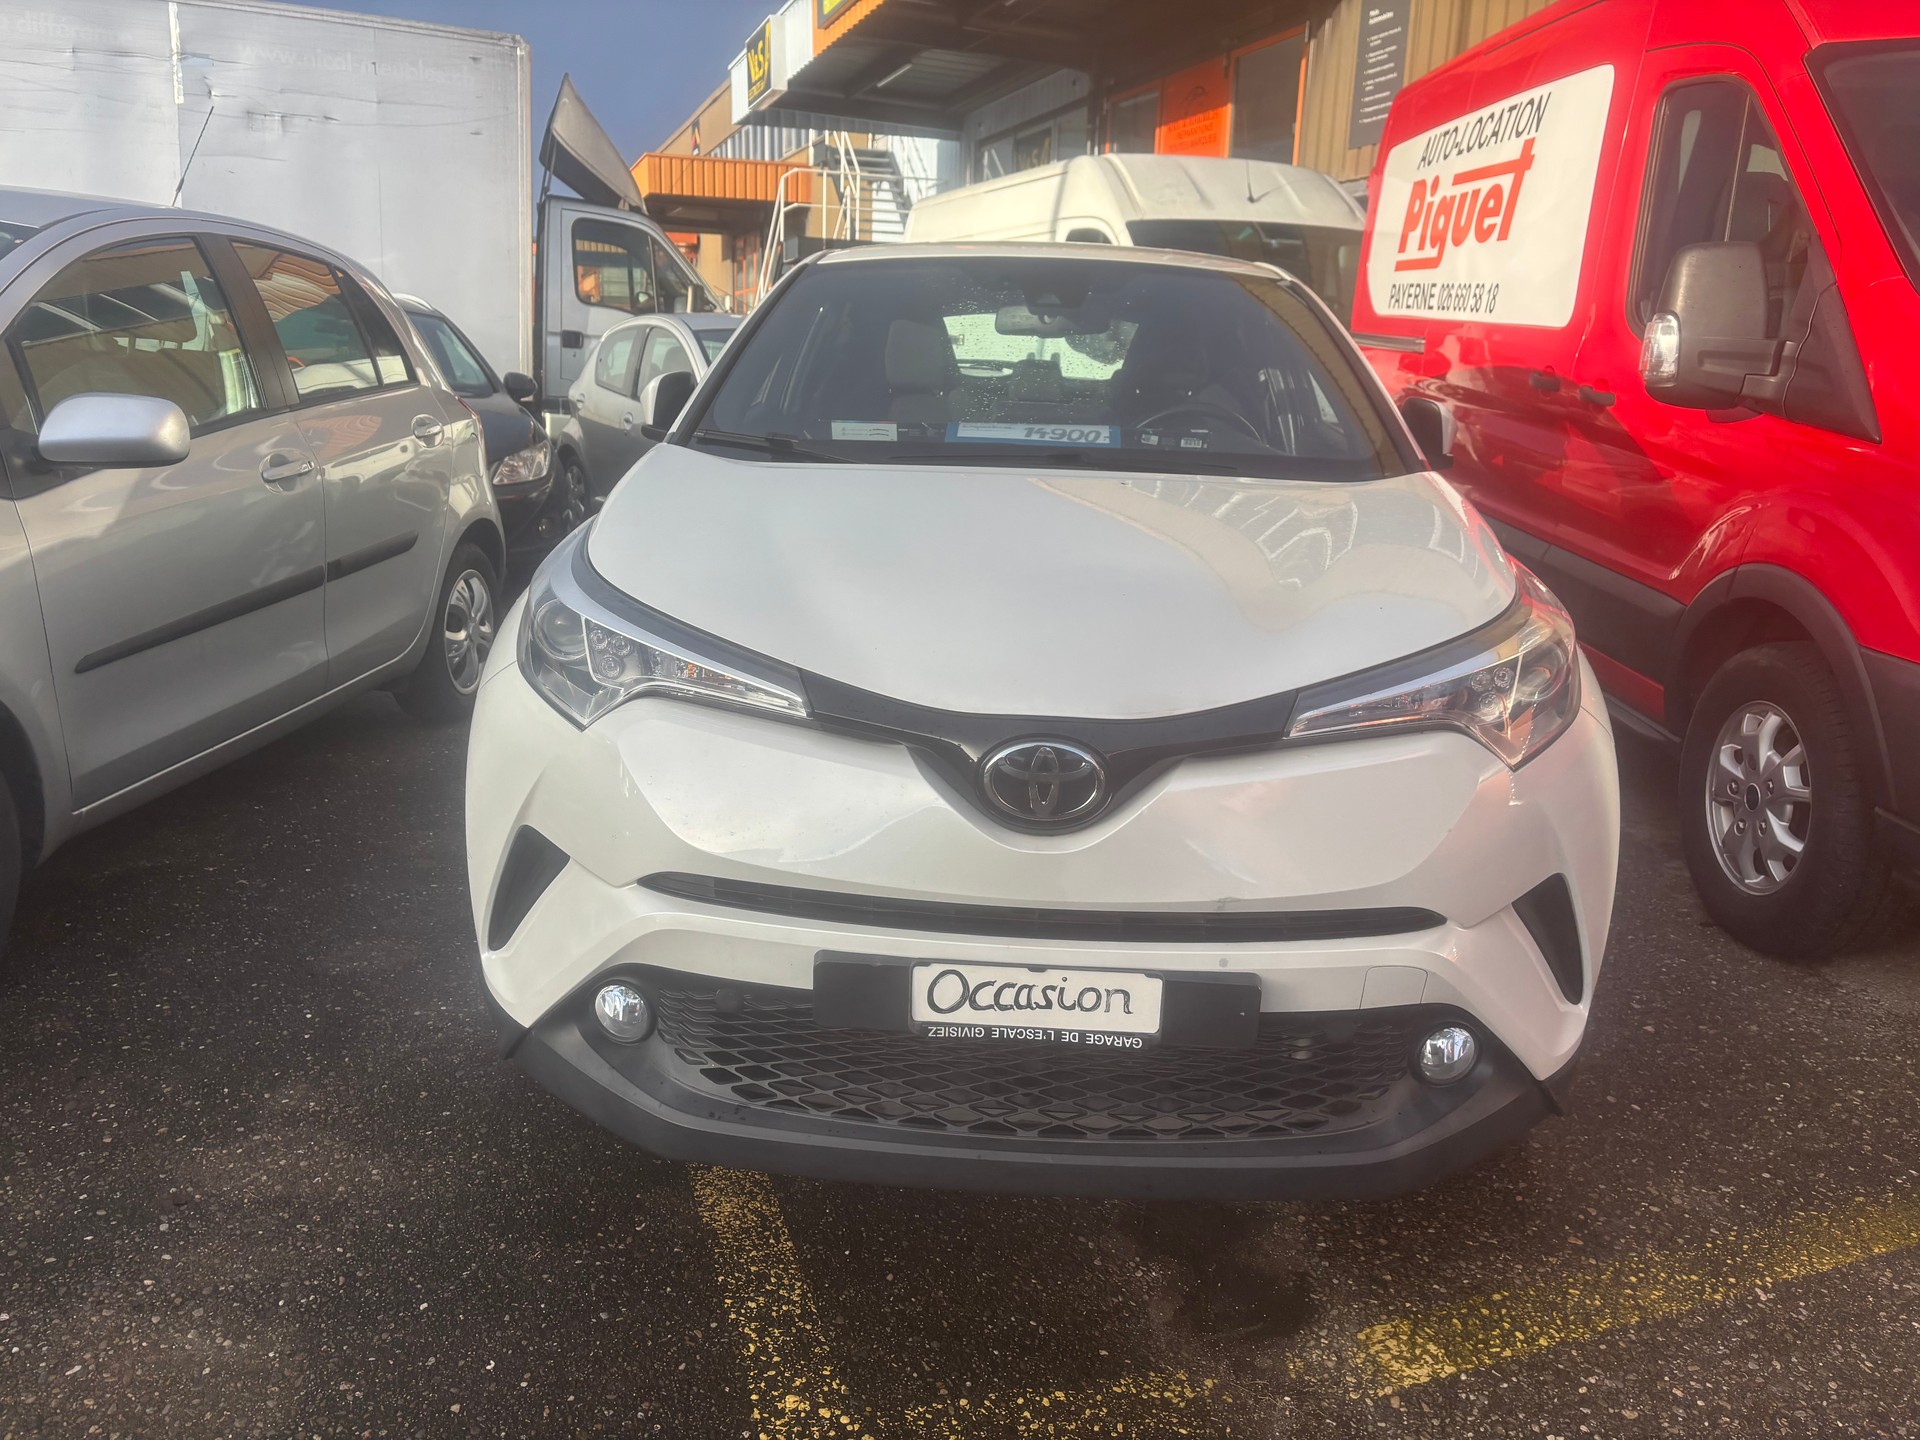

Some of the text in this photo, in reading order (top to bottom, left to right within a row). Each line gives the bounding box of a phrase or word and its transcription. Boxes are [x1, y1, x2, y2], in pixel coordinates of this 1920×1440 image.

[1417, 92, 1552, 170] AUTO-LOCATION
[1394, 137, 1535, 272] Piguet
[1388, 282, 1437, 310] PAYERNE
[1437, 283, 1454, 311] 026
[1471, 284, 1485, 313] 58
[1485, 283, 1499, 314] 18
[927, 968, 1134, 1015] Occasion
[928, 1026, 1143, 1048] GARAGE DE L'ESCALE GIVISIEZ
